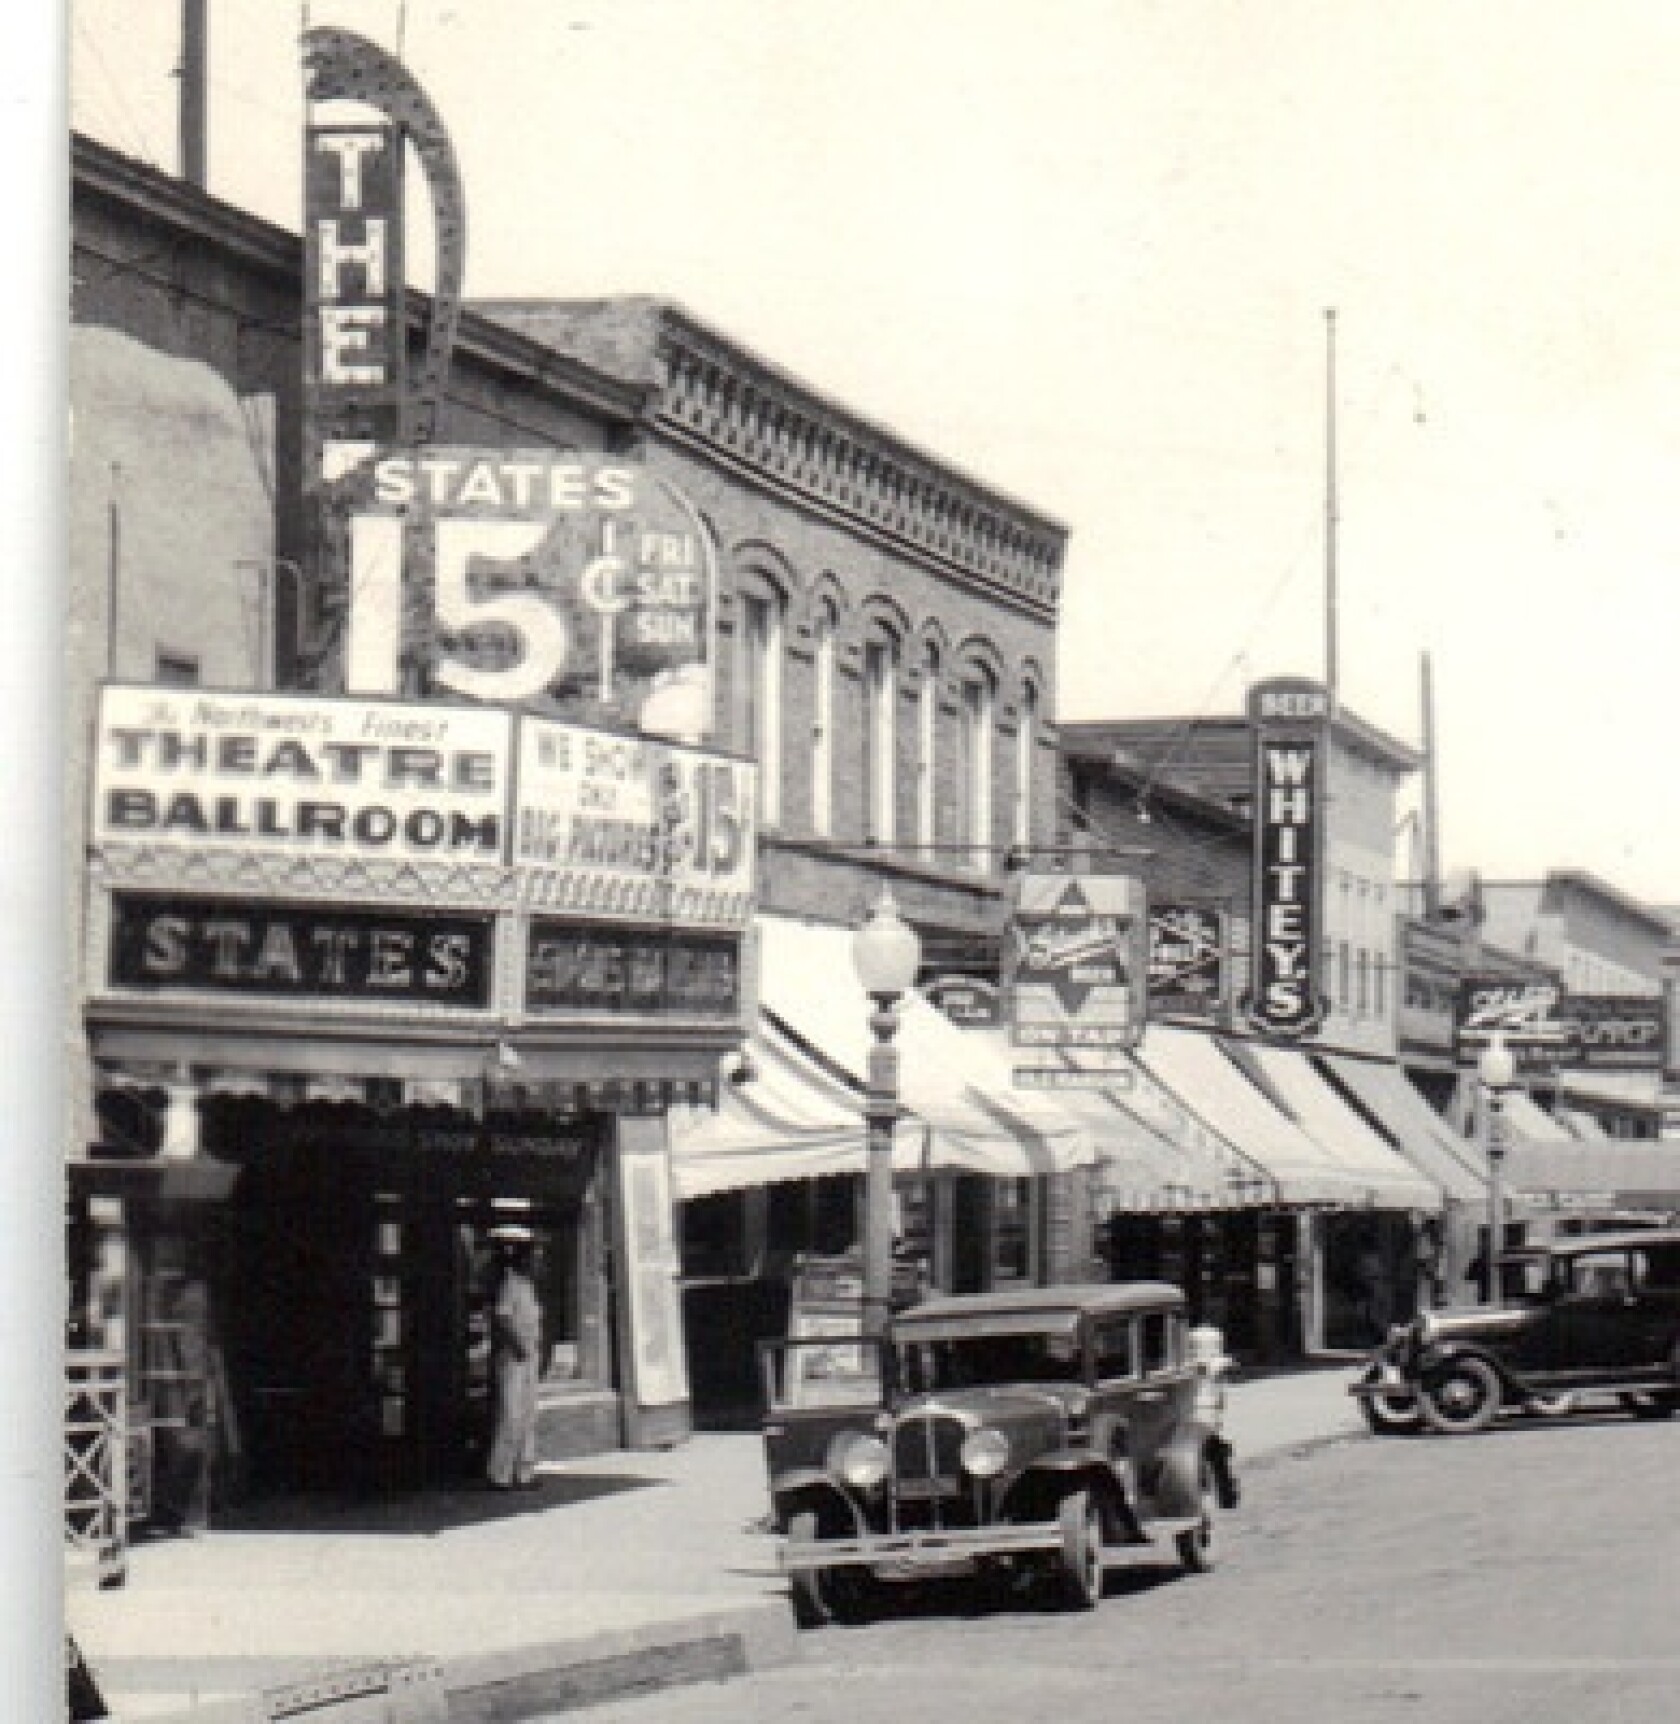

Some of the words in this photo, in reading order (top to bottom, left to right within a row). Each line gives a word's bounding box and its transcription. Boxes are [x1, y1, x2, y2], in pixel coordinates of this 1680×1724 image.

[315, 132, 388, 386] THE
[374, 461, 634, 509] STATES
[640, 533, 695, 567] FRI
[638, 571, 697, 606] SAT
[637, 610, 696, 643] SUN
[362, 708, 449, 742] Finest
[110, 727, 495, 790] THEATRE
[110, 788, 499, 850] BALLROOM
[144, 918, 472, 987] STATES
